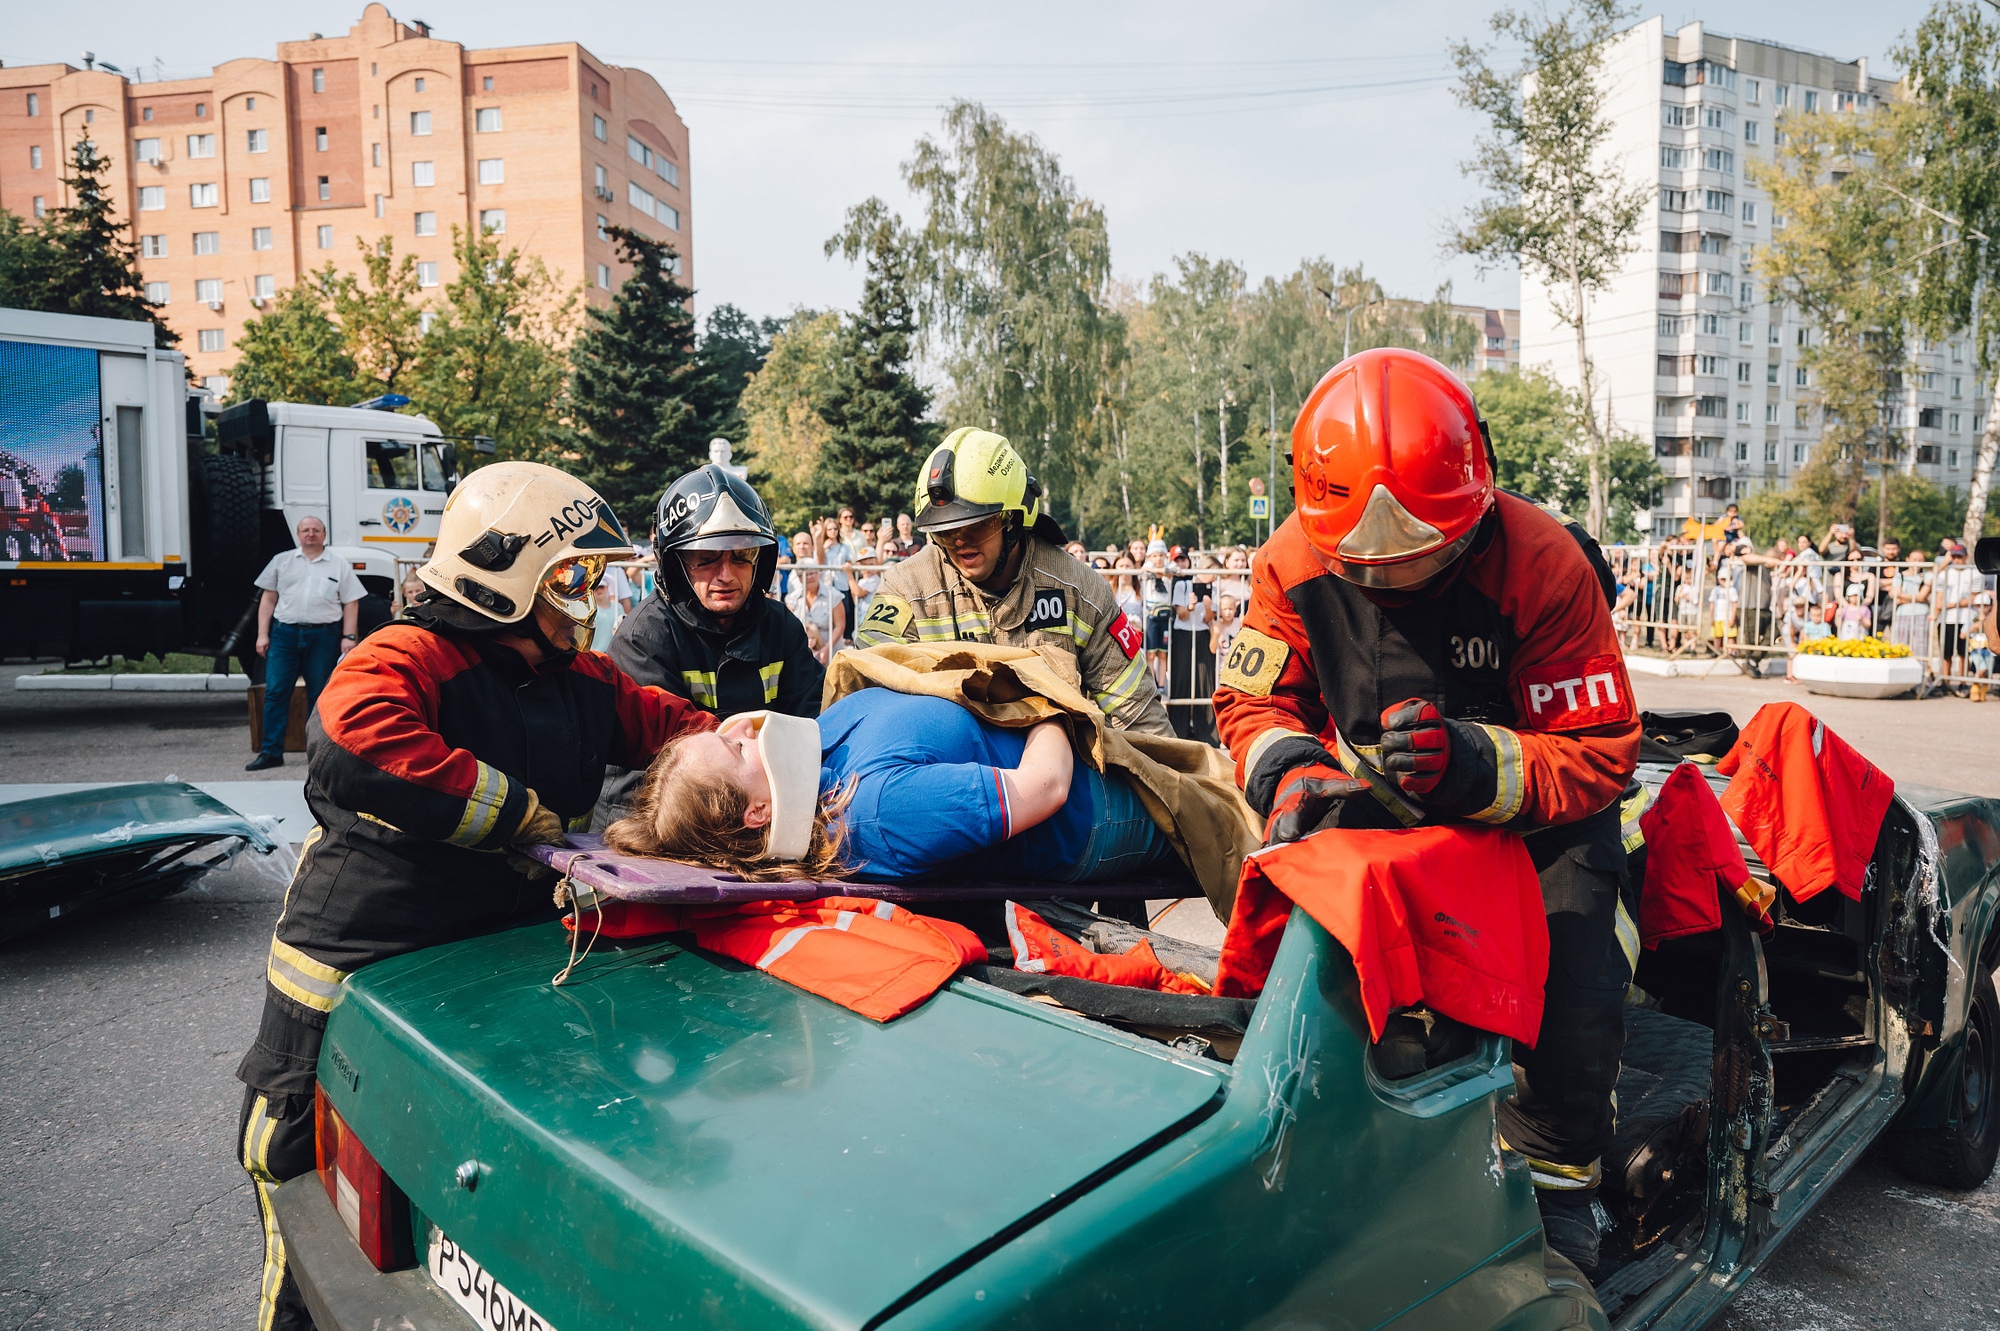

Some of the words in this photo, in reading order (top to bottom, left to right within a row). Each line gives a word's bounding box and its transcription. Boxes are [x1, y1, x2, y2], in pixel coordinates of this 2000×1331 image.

[550, 499, 593, 541] АСО
[669, 492, 701, 527] АСО
[868, 603, 900, 625] 22
[1228, 642, 1265, 677] 60
[1451, 635, 1500, 670] 300
[1529, 672, 1618, 715] РТП
